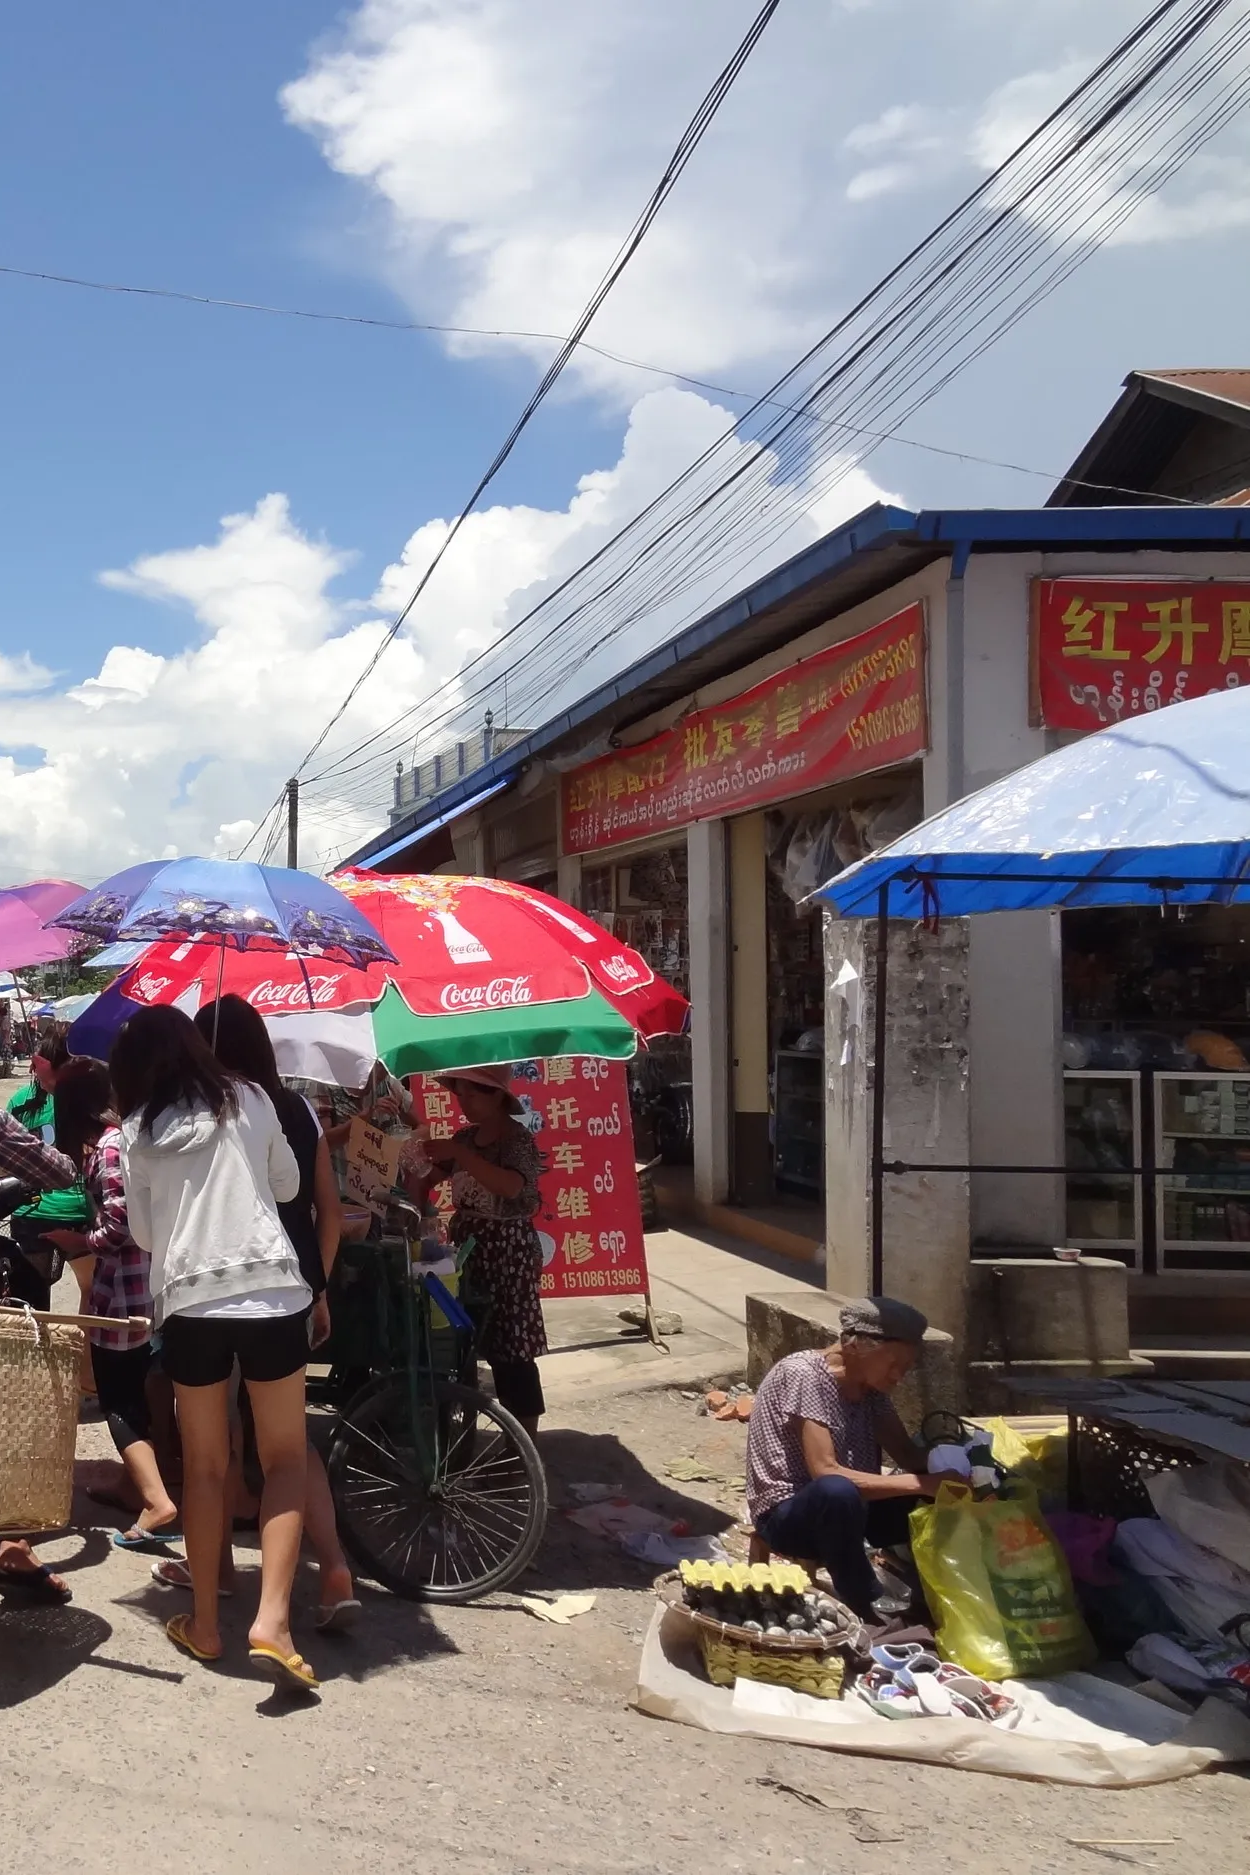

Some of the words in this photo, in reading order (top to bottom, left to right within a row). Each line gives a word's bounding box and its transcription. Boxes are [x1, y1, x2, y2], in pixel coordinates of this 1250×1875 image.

[247, 972, 346, 1008] Coca-Cola
[440, 974, 533, 1010] Coca-Cola
[543, 1057, 595, 1265] 摩托车维修
[562, 1268, 641, 1289] 15108613966
